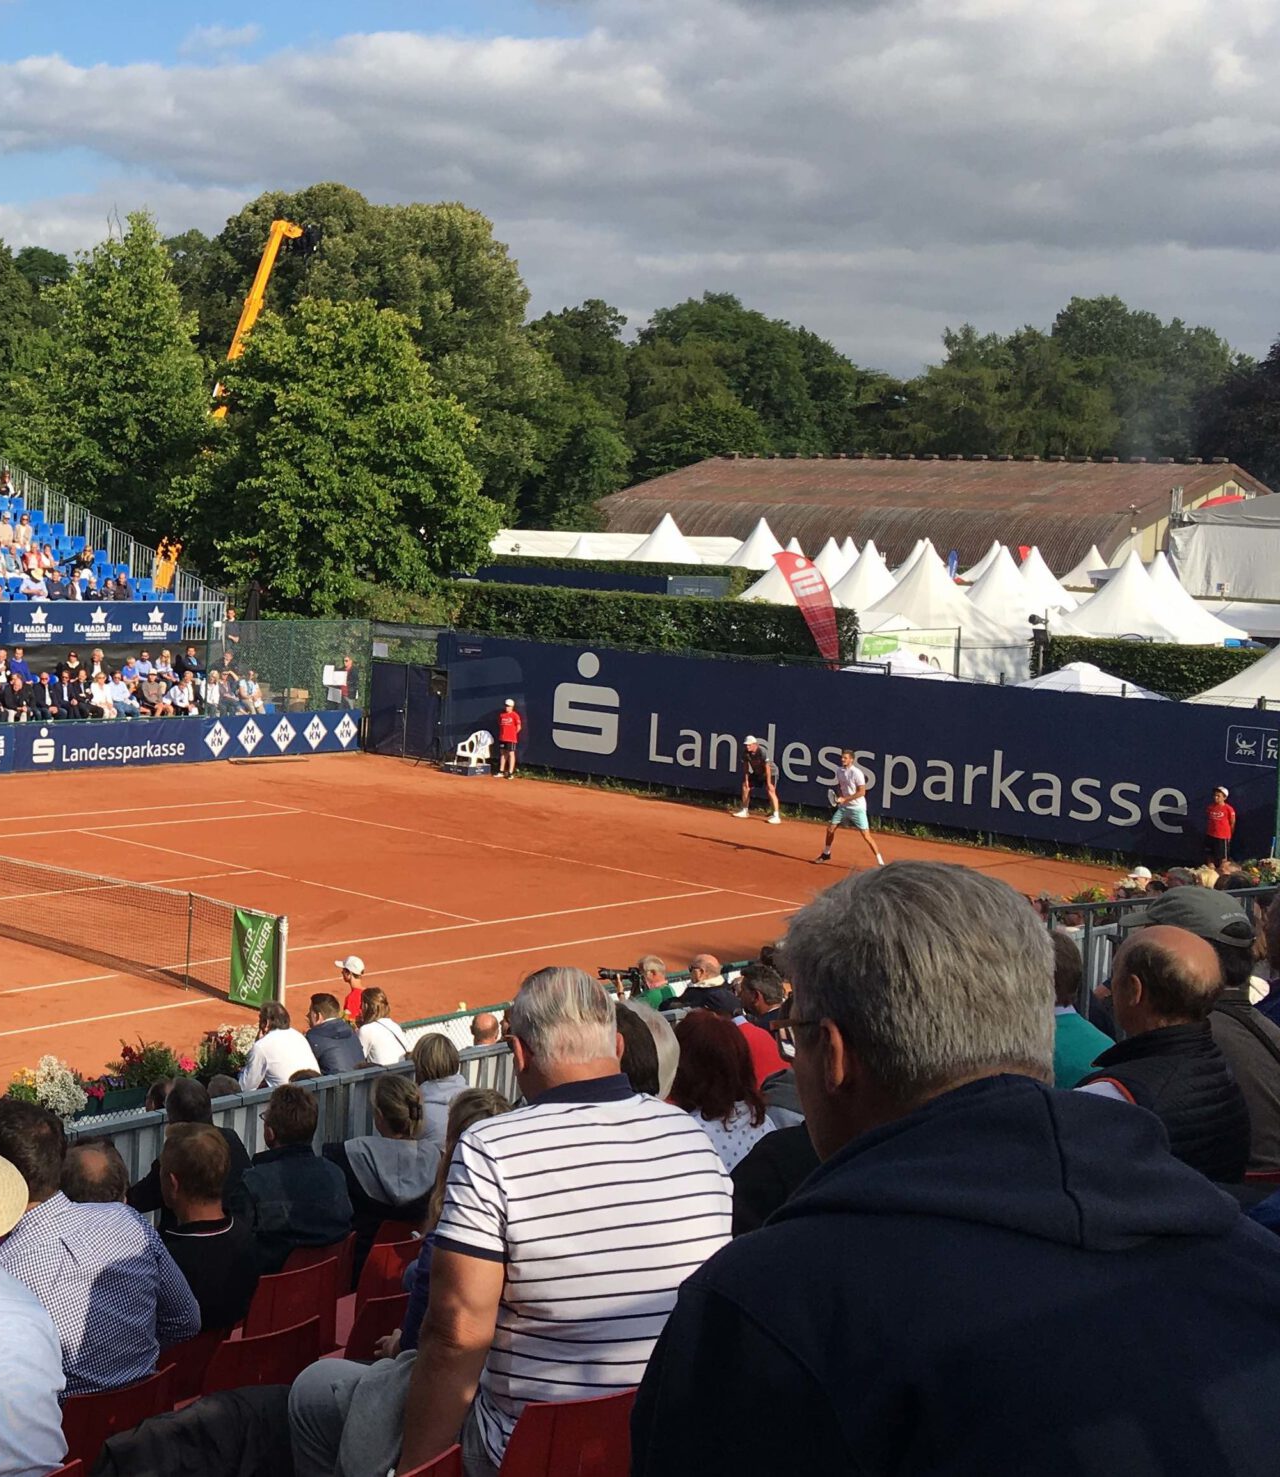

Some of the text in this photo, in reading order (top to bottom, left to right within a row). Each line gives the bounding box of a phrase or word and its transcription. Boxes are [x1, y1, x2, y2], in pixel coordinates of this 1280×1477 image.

[279, 724, 288, 732] M
[311, 722, 320, 730] M
[342, 720, 350, 728] M
[213, 728, 221, 736] M
[246, 725, 254, 734] M
[339, 728, 351, 738] KN
[243, 734, 256, 744] KN
[277, 732, 290, 742] KN
[309, 730, 321, 740] KN
[210, 736, 223, 747] KN
[62, 740, 186, 764] Landessparkasse
[241, 927, 256, 959] ATP
[239, 922, 273, 1001] CHALLENGER
[251, 959, 268, 994] TOUR
